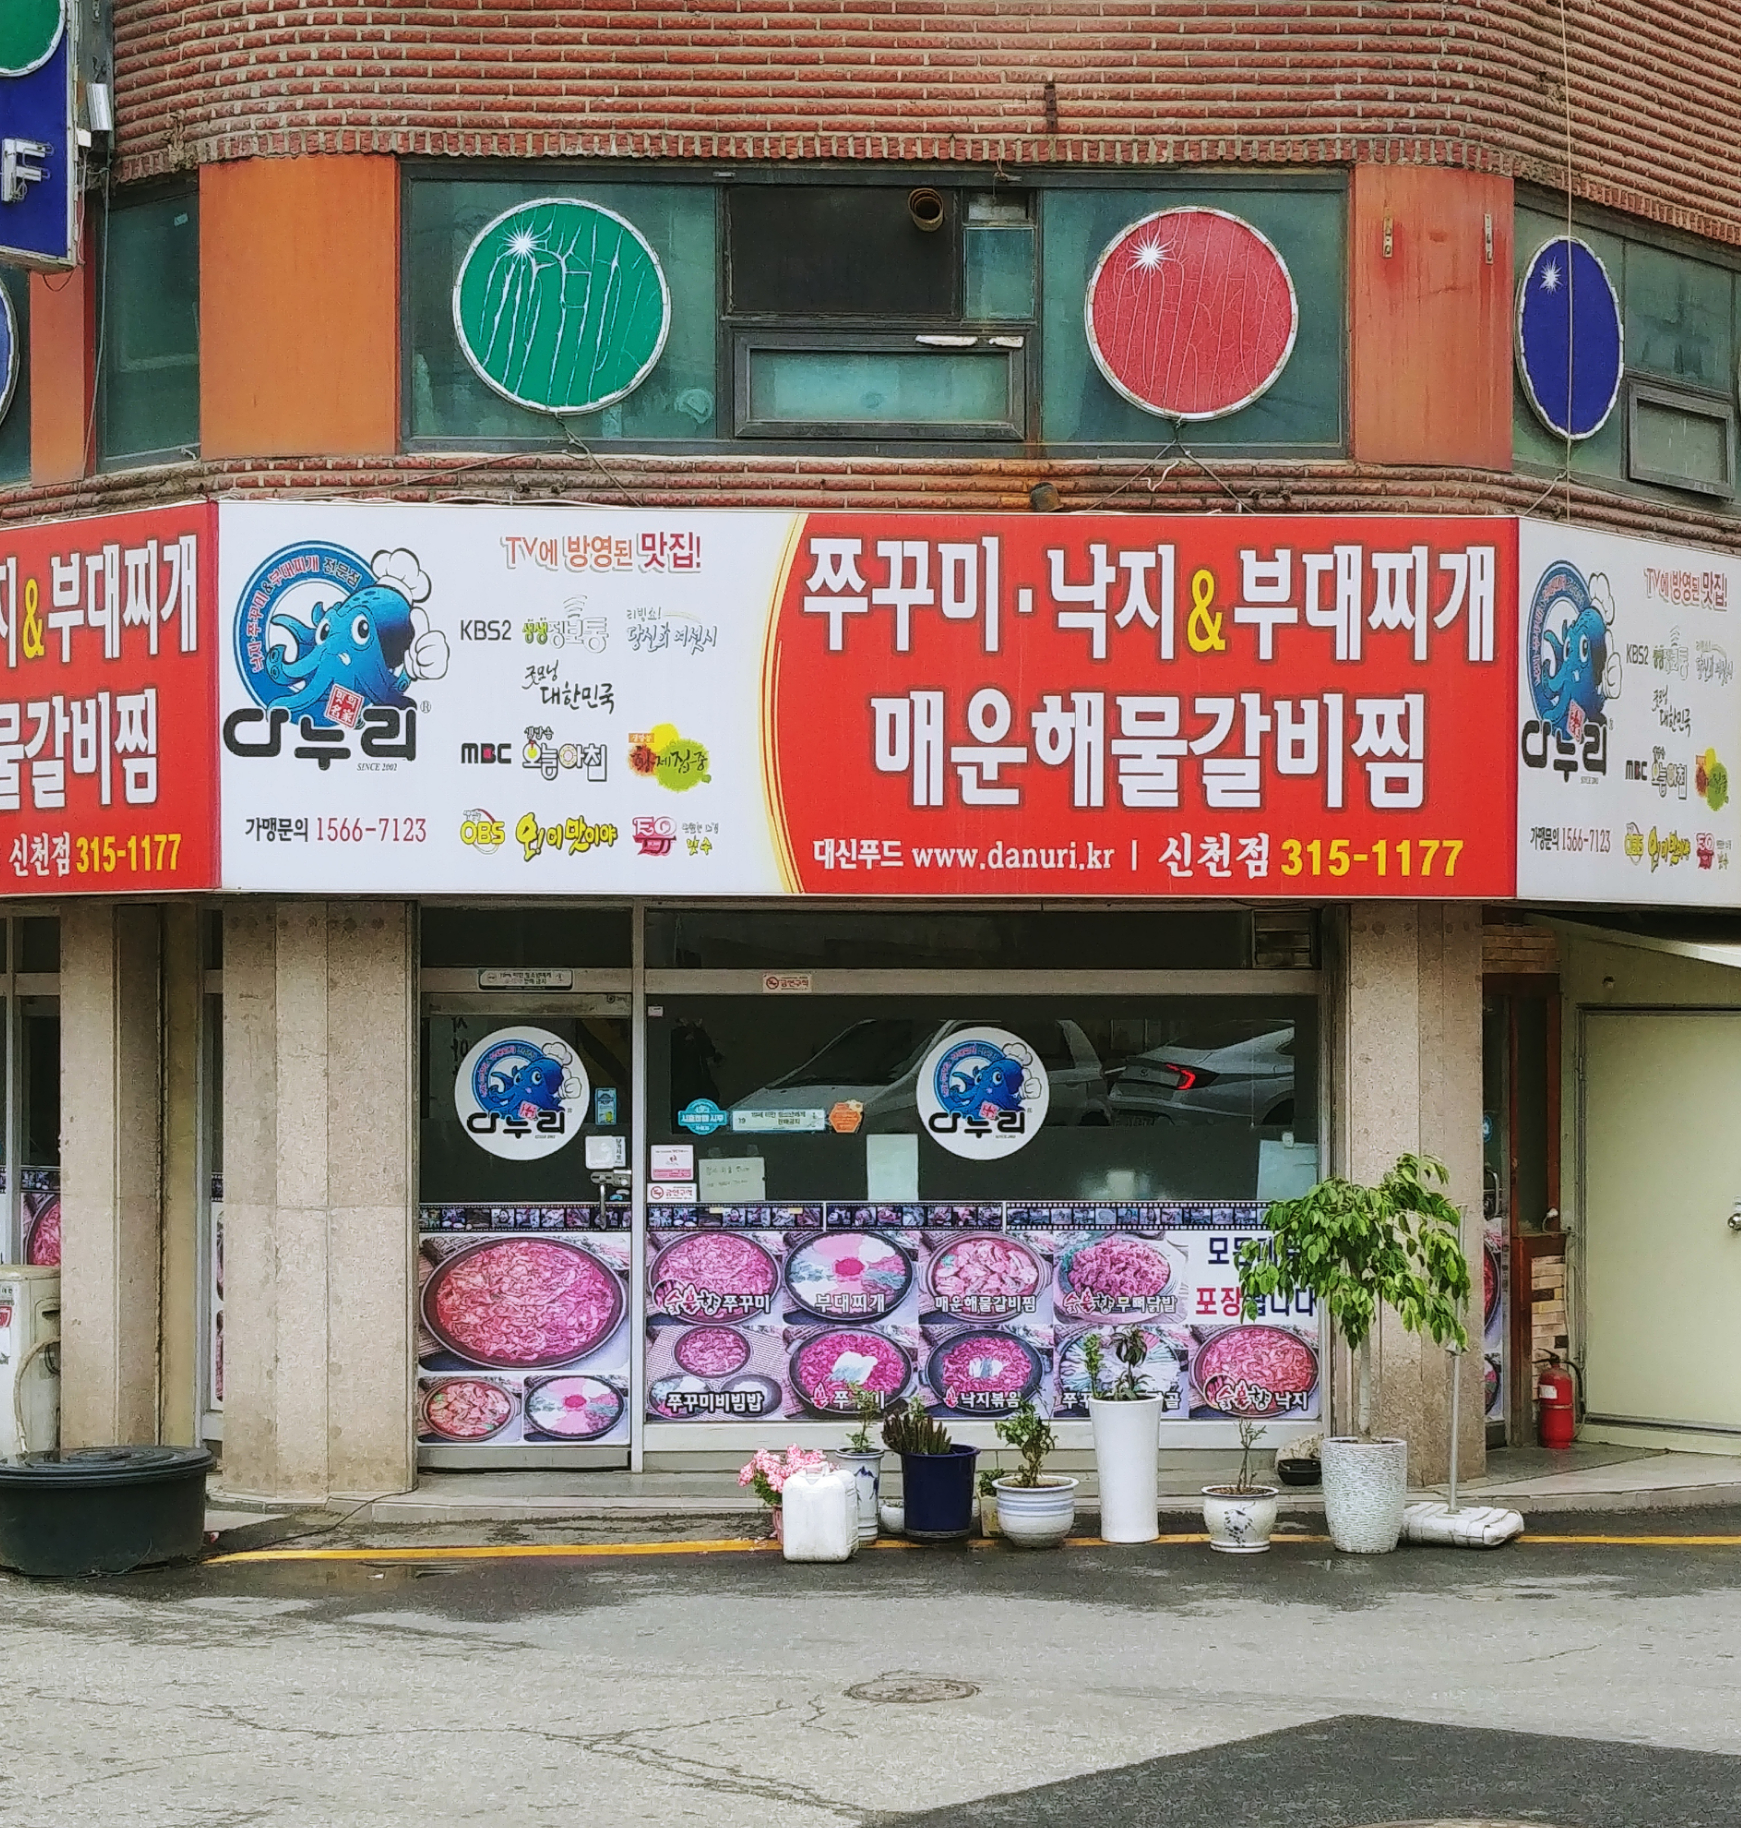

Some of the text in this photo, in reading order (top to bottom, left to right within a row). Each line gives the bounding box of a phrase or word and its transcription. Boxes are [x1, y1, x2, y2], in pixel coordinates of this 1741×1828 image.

[502, 532, 701, 572] TV에 방영된 맛집!
[324, 557, 362, 588] 전문점
[23, 578, 44, 659] &
[48, 534, 198, 663] 부대찌개
[1187, 569, 1226, 653] &
[1234, 545, 1495, 662] 부대찌개
[460, 619, 511, 641] KBS2
[540, 681, 615, 714] 대한민국
[223, 706, 416, 771] 다누리
[871, 687, 1425, 809] 매운해물갈비찜
[1521, 719, 1608, 784] 다누리
[461, 740, 607, 781] MBC 오늘아침
[245, 816, 427, 844] 가맹문의 1566-7123
[460, 820, 506, 845] OBS
[1530, 825, 1611, 854] 가맹문의 1566-7123
[9, 830, 182, 878] 신천점 315-1177
[812, 832, 1465, 878] 대신푸드 www.danuri.kr 신천점 315-1177
[466, 1112, 565, 1139] 다누리
[929, 1111, 1025, 1139] 다누리
[722, 1294, 771, 1314] 쭈꾸미
[815, 1292, 886, 1314] 부대찌개
[666, 1392, 764, 1413] 쭈꾸미비빔밥
[1274, 1390, 1308, 1411] 낙지
